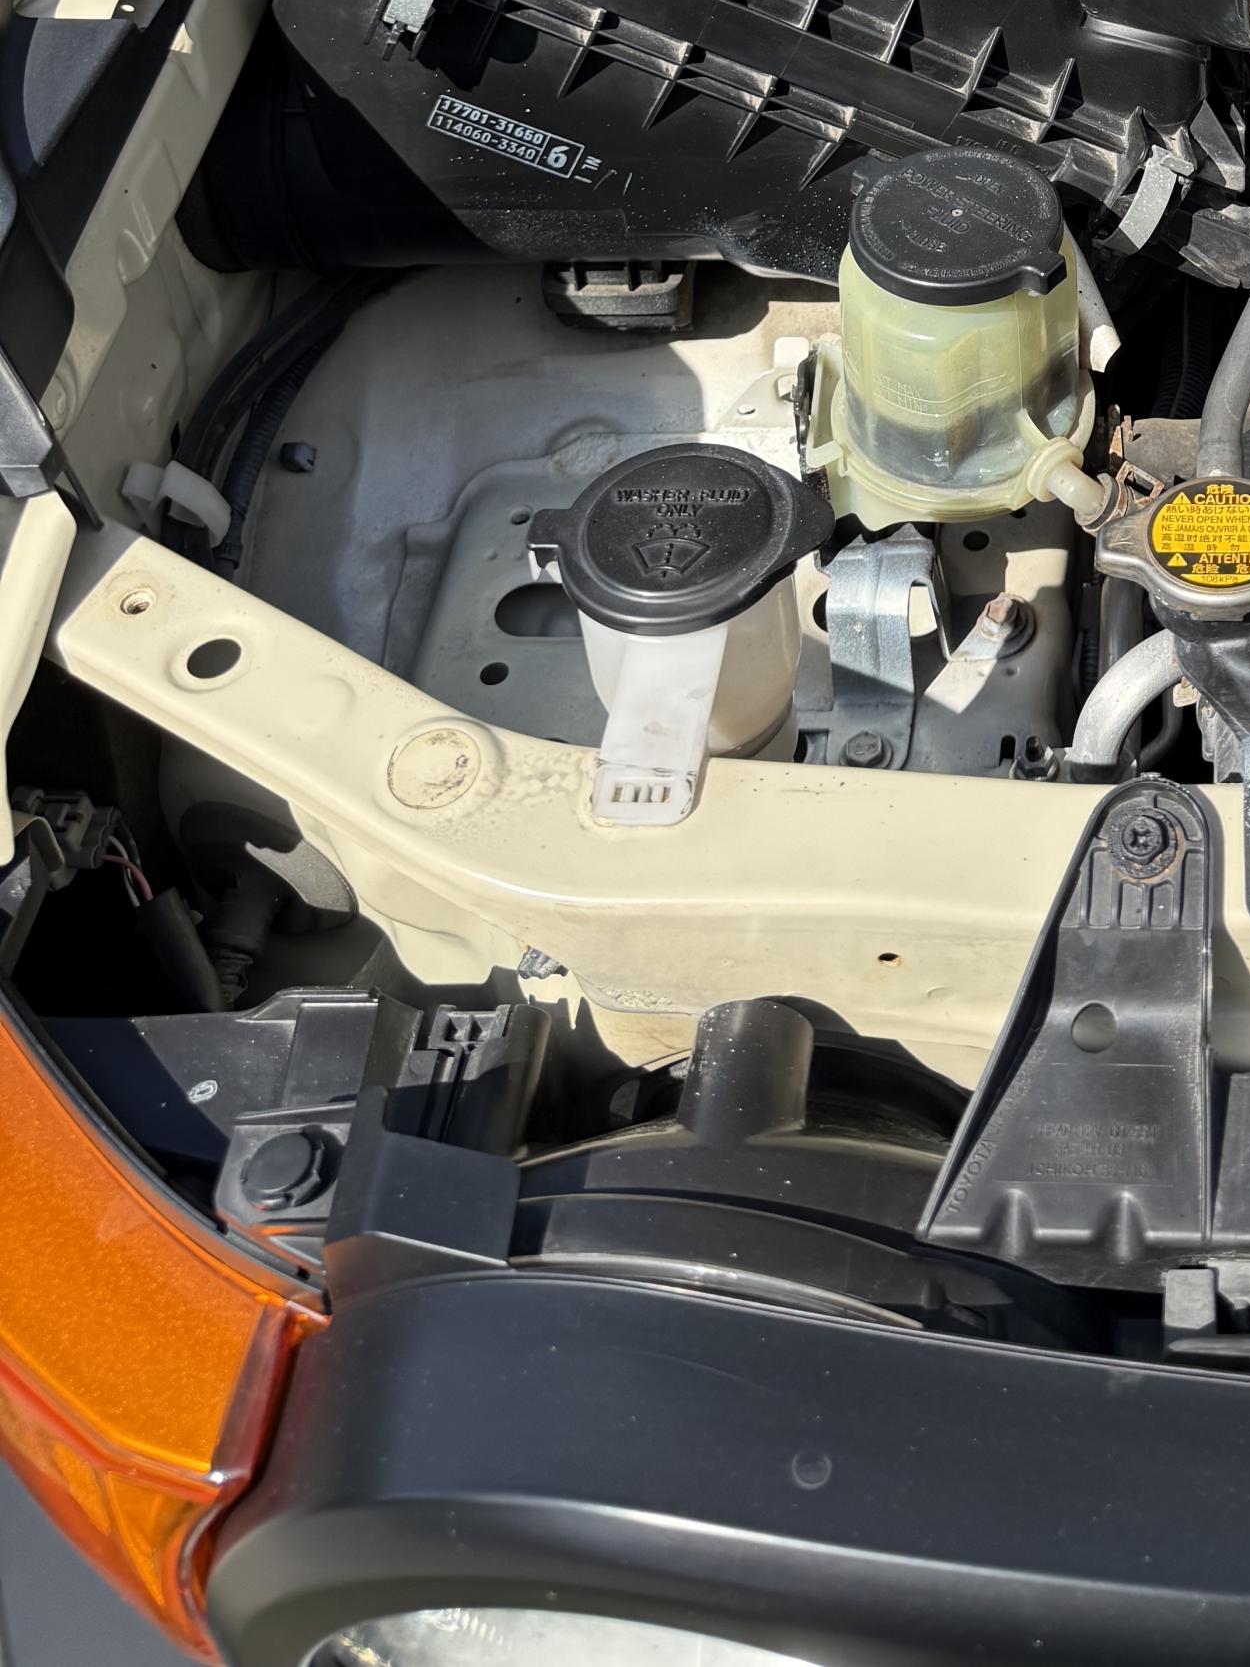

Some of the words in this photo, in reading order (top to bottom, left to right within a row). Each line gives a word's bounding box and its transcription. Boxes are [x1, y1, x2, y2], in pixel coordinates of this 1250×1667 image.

[434, 114, 537, 161] 114060-3340
[546, 145, 570, 169] 6
[900, 167, 957, 202] POWER
[954, 195, 1033, 243] STEERING
[926, 204, 971, 235] FLUID
[615, 488, 691, 503] WASHER
[699, 487, 752, 505] FLUID
[656, 503, 703, 518] ONLY
[1161, 515, 1194, 523] NEVER
[1196, 515, 1223, 524] OPEN
[1161, 524, 1173, 532] NE
[1175, 524, 1205, 533] JAMAIS
[1206, 525, 1238, 533] OUVRIR
[948, 1137, 998, 1215] TOYOTA
